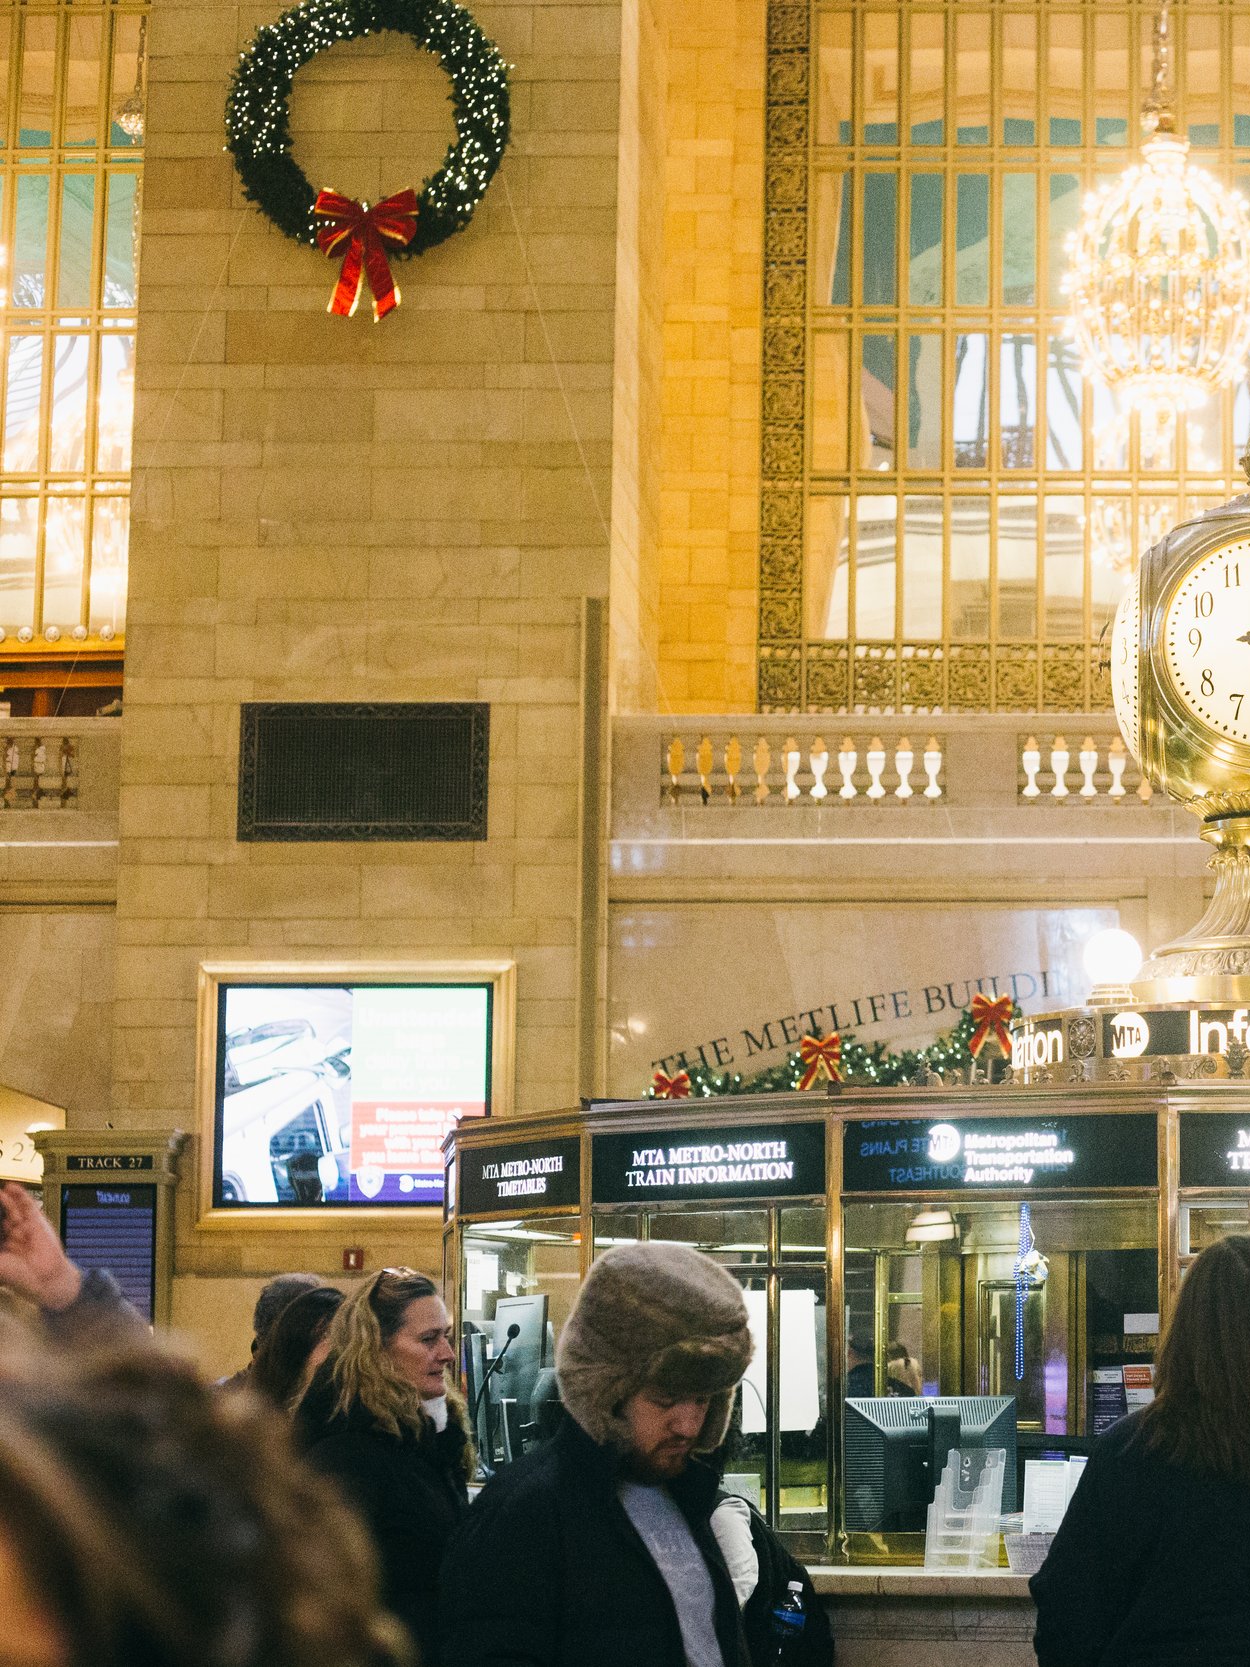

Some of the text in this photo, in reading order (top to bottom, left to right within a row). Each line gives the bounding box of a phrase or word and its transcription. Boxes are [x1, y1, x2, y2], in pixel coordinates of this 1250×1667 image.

[1224, 563, 1240, 588] 11
[1193, 591, 1214, 618] 10
[1188, 628, 1202, 658] 9
[1200, 668, 1216, 697] 8
[1229, 693, 1245, 721] 7
[651, 1037, 735, 1077] THE
[740, 988, 914, 1058] METLIFE
[1110, 1024, 1142, 1050] MTA
[632, 1141, 788, 1167] MTA METRO-NORTH
[964, 1132, 1058, 1151] Metropolitan
[78, 1156, 144, 1168] TRACK 27
[482, 1155, 564, 1180] MTA METRO-NORTH
[964, 1147, 1074, 1167] Transportation
[496, 1176, 547, 1198] TIMETABLES
[625, 1161, 794, 1187] TRAIN INFORMATION
[964, 1166, 1034, 1184] Authority
